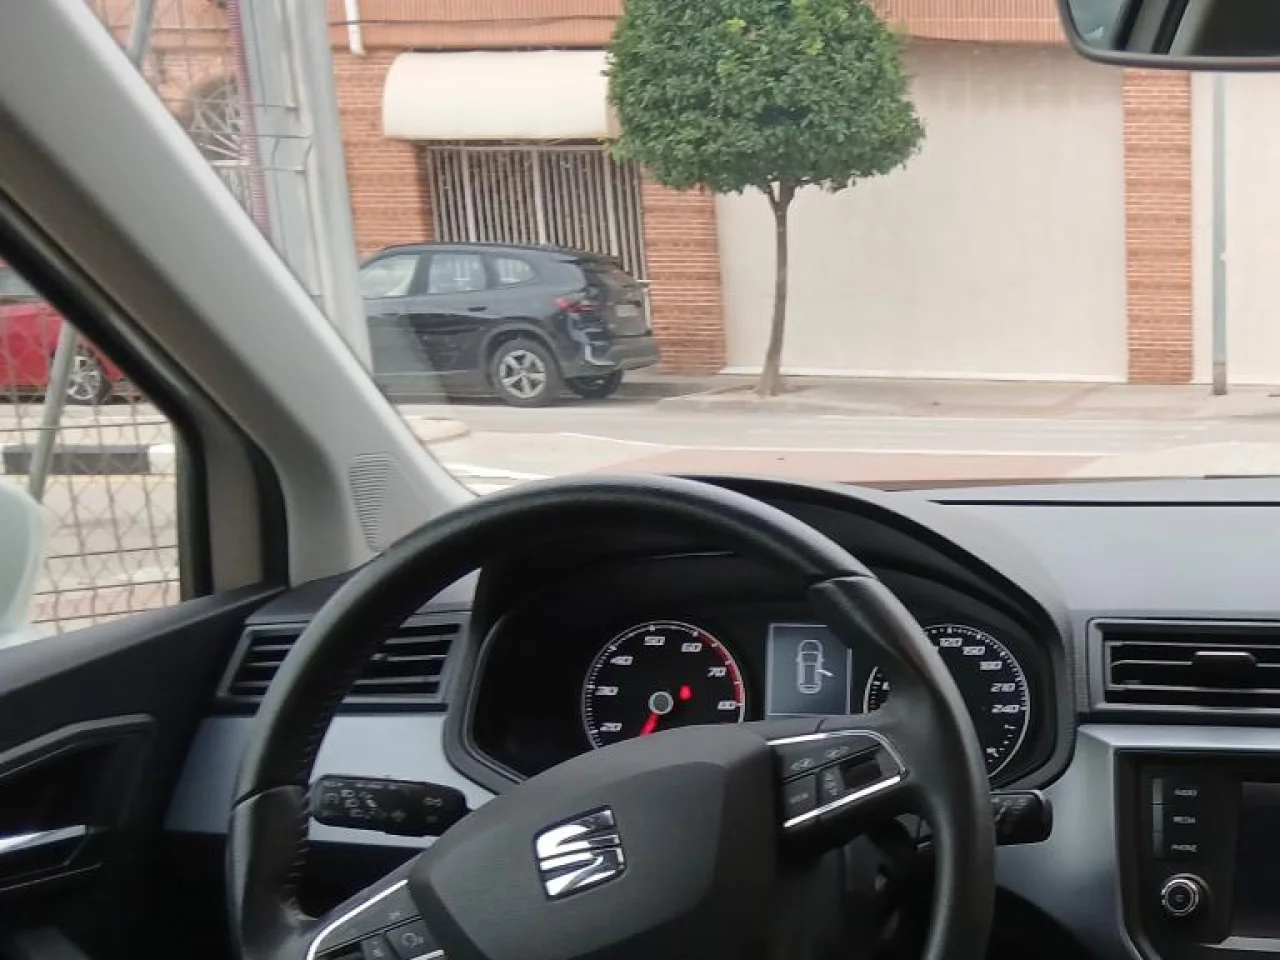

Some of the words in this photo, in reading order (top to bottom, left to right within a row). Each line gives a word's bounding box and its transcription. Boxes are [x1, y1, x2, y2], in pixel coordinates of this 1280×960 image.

[643, 636, 666, 646] 50
[681, 642, 703, 653] 60
[609, 656, 634, 666] 40
[707, 666, 728, 678] 70
[594, 686, 619, 696] 30
[990, 683, 1016, 693] 210
[716, 700, 737, 711] 80
[991, 704, 1021, 714] 240
[599, 722, 623, 732] 20
